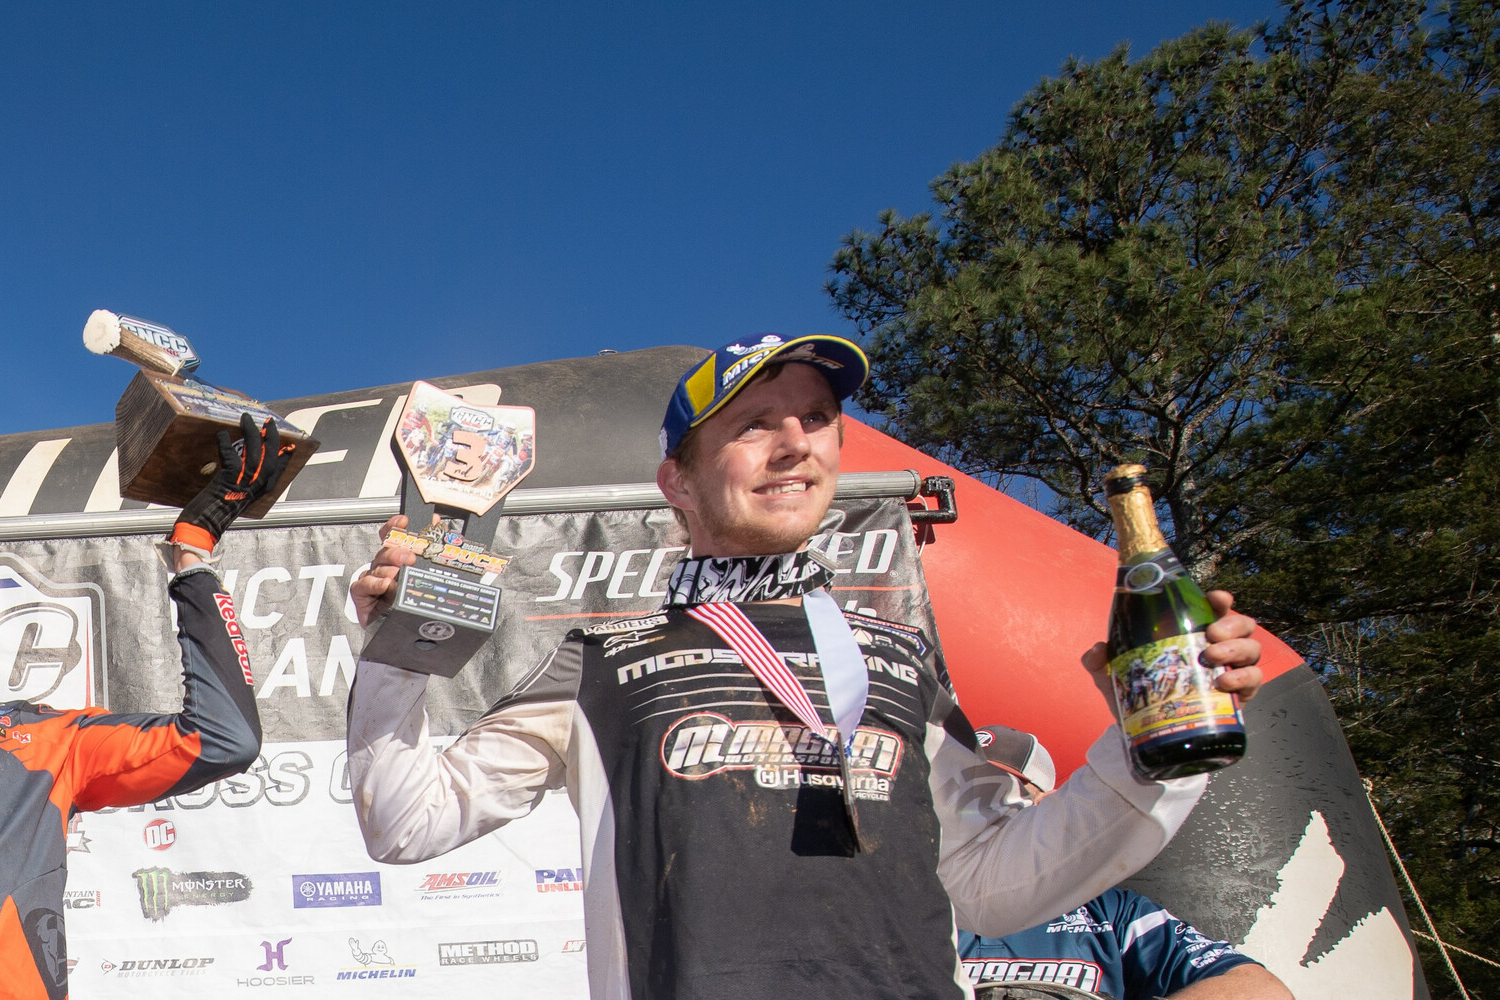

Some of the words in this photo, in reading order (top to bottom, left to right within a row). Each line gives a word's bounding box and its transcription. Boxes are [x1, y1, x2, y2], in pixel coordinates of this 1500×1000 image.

[444, 430, 488, 482] 3
[440, 543, 508, 573] BUCK
[146, 819, 176, 849] DC
[172, 879, 246, 892] MONSTER
[317, 879, 373, 896] YAMAHA
[423, 871, 499, 890] AMSOIL
[440, 941, 538, 958] METHOD
[118, 957, 215, 971] DUNLOP
[441, 956, 475, 965] RACE
[482, 953, 537, 963] WHEELS
[236, 975, 315, 988] HOOSIER
[336, 968, 417, 980] MICHELIN
